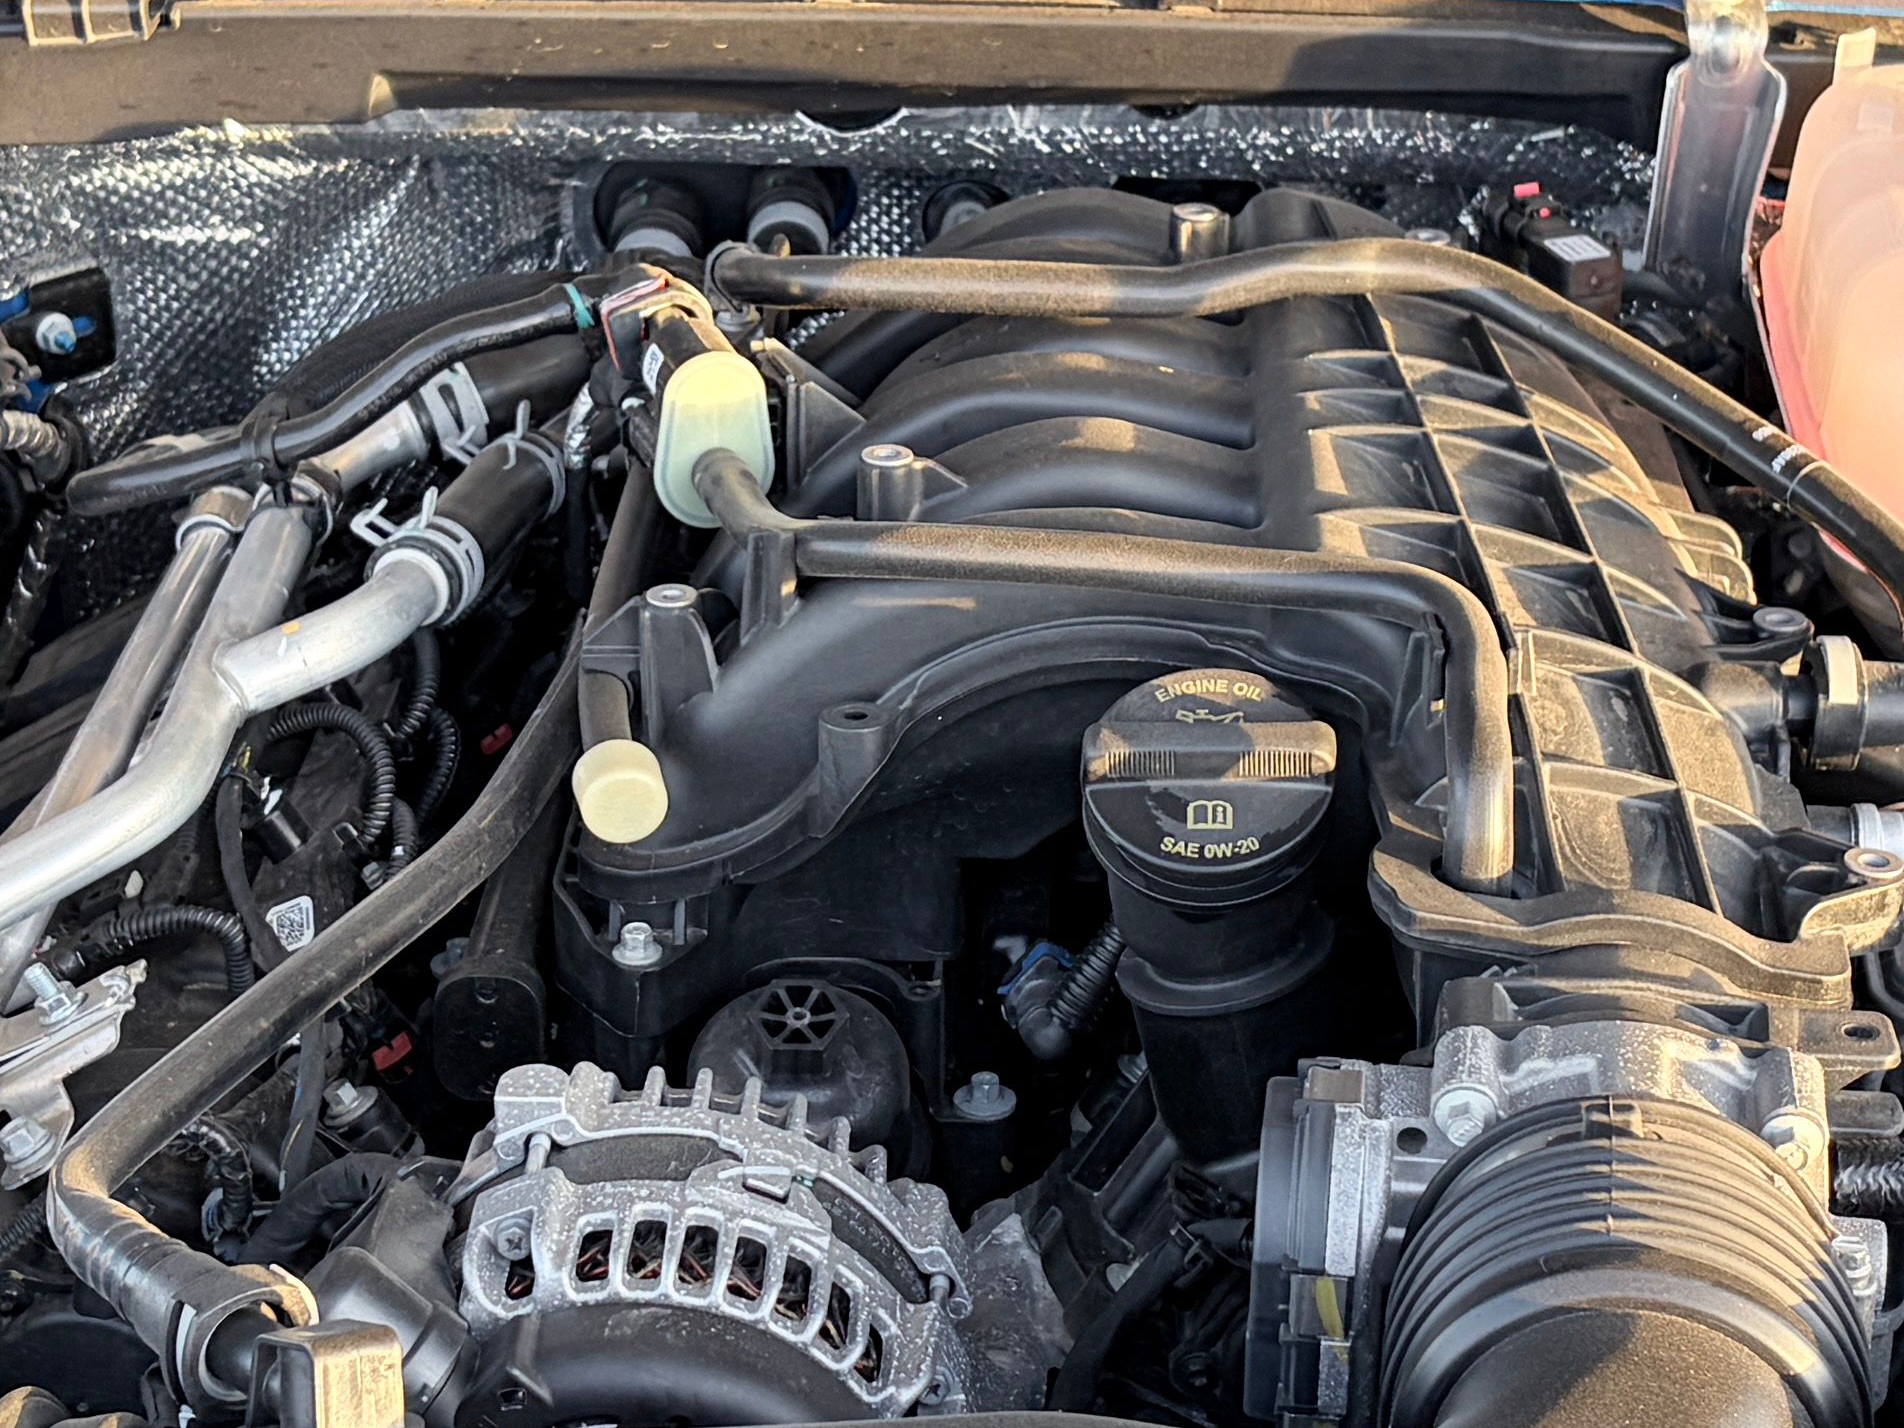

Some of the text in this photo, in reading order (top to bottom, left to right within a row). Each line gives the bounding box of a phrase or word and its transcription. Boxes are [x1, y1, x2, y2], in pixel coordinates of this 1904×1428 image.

[1154, 678, 1266, 703] ENGINE OIL
[1159, 836, 1261, 859] SAE 0W-20
